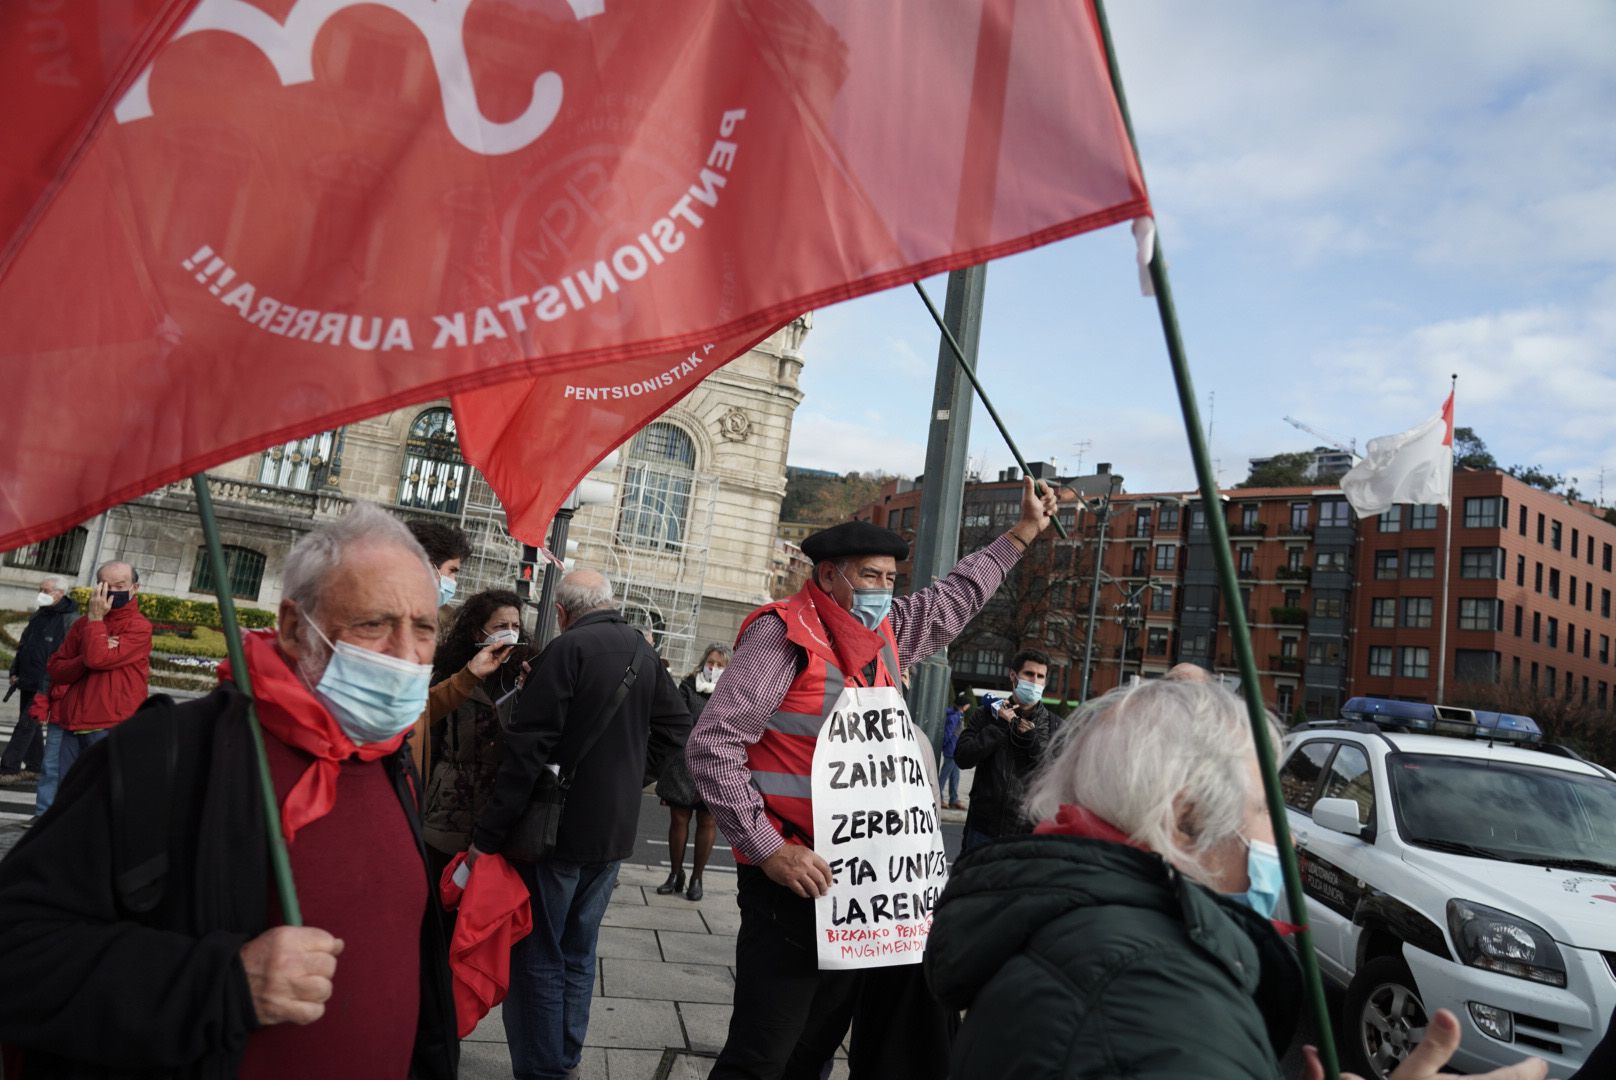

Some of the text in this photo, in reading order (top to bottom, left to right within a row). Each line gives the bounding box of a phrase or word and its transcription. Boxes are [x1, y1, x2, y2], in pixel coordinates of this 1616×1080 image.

[564, 352, 702, 400] PENTSIONISTAK
[828, 707, 914, 743] ARRETA
[832, 806, 934, 845] ZERBITZU
